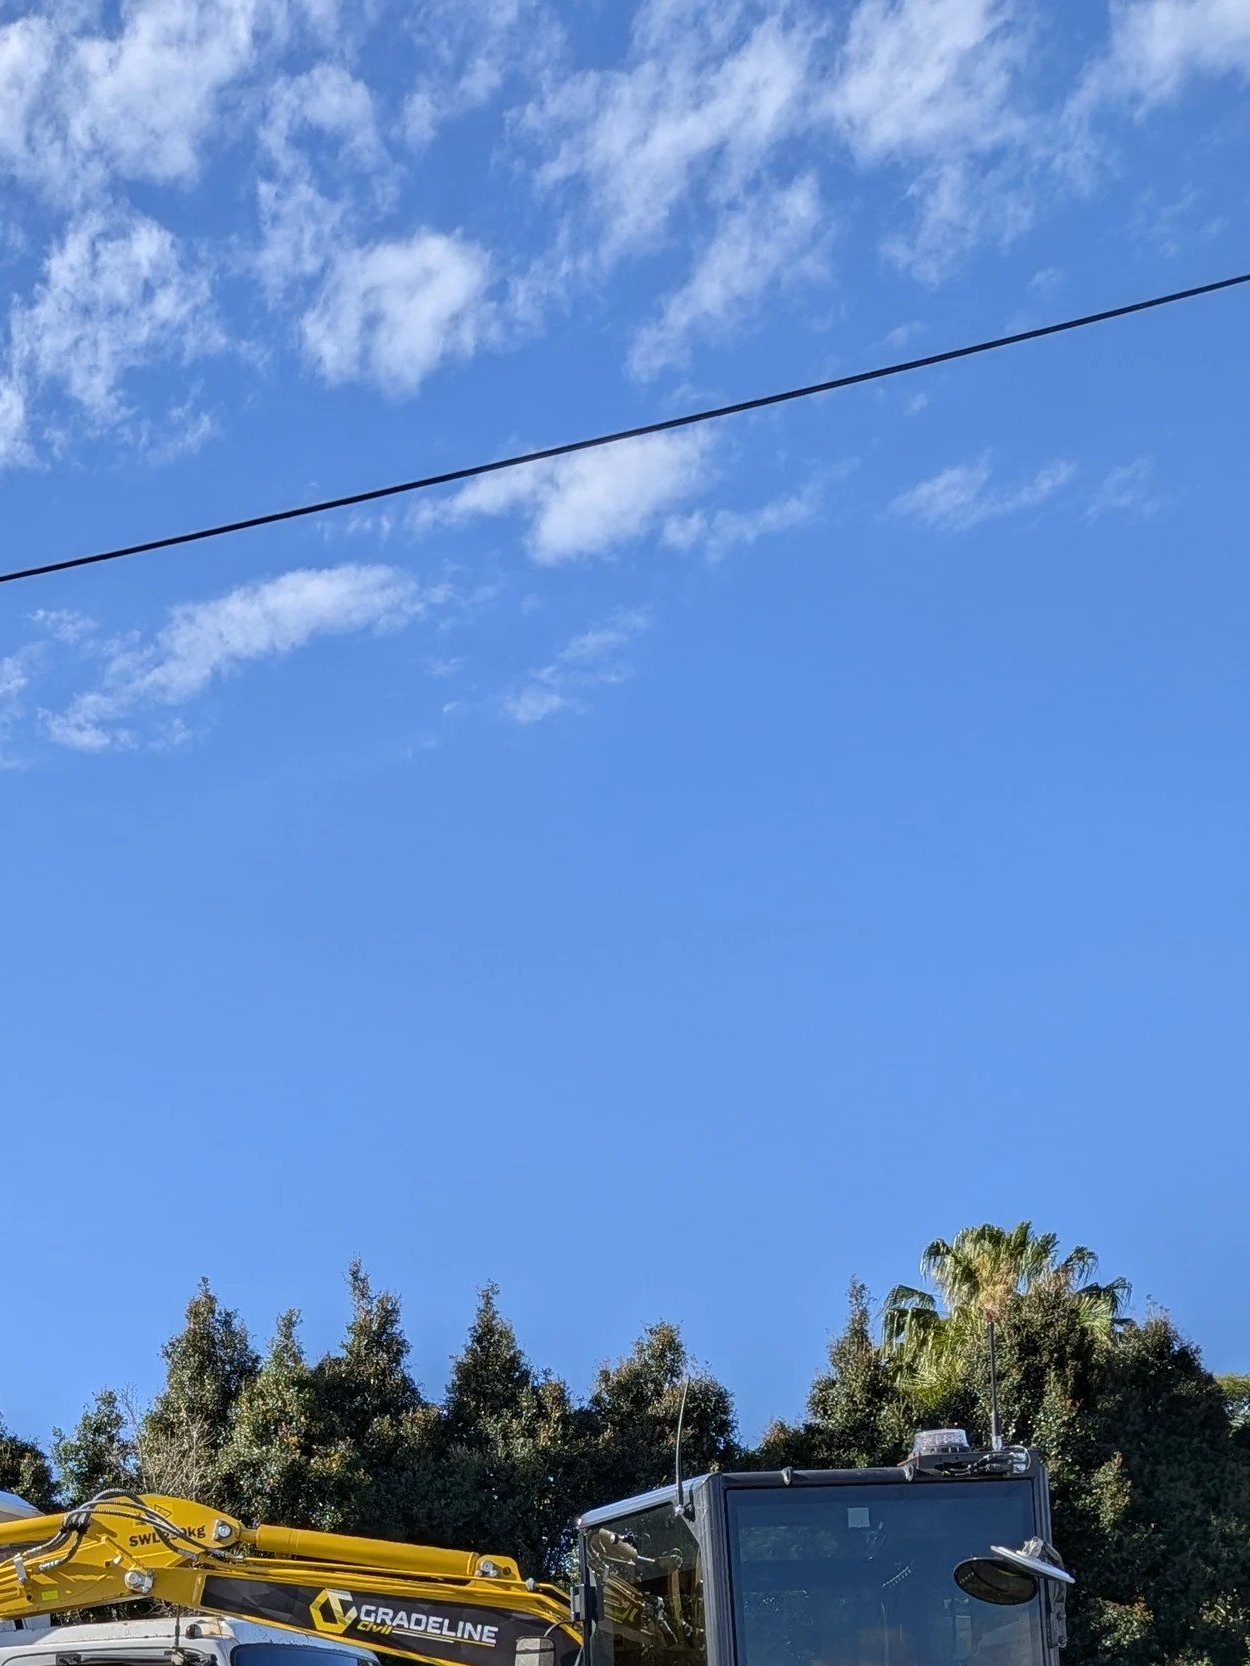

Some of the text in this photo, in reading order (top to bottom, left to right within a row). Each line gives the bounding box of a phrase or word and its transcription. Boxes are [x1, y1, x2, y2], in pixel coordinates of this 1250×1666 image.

[129, 1532, 161, 1547] SWL
[356, 1621, 393, 1636] Civil
[359, 1604, 499, 1644] GRADELINE
